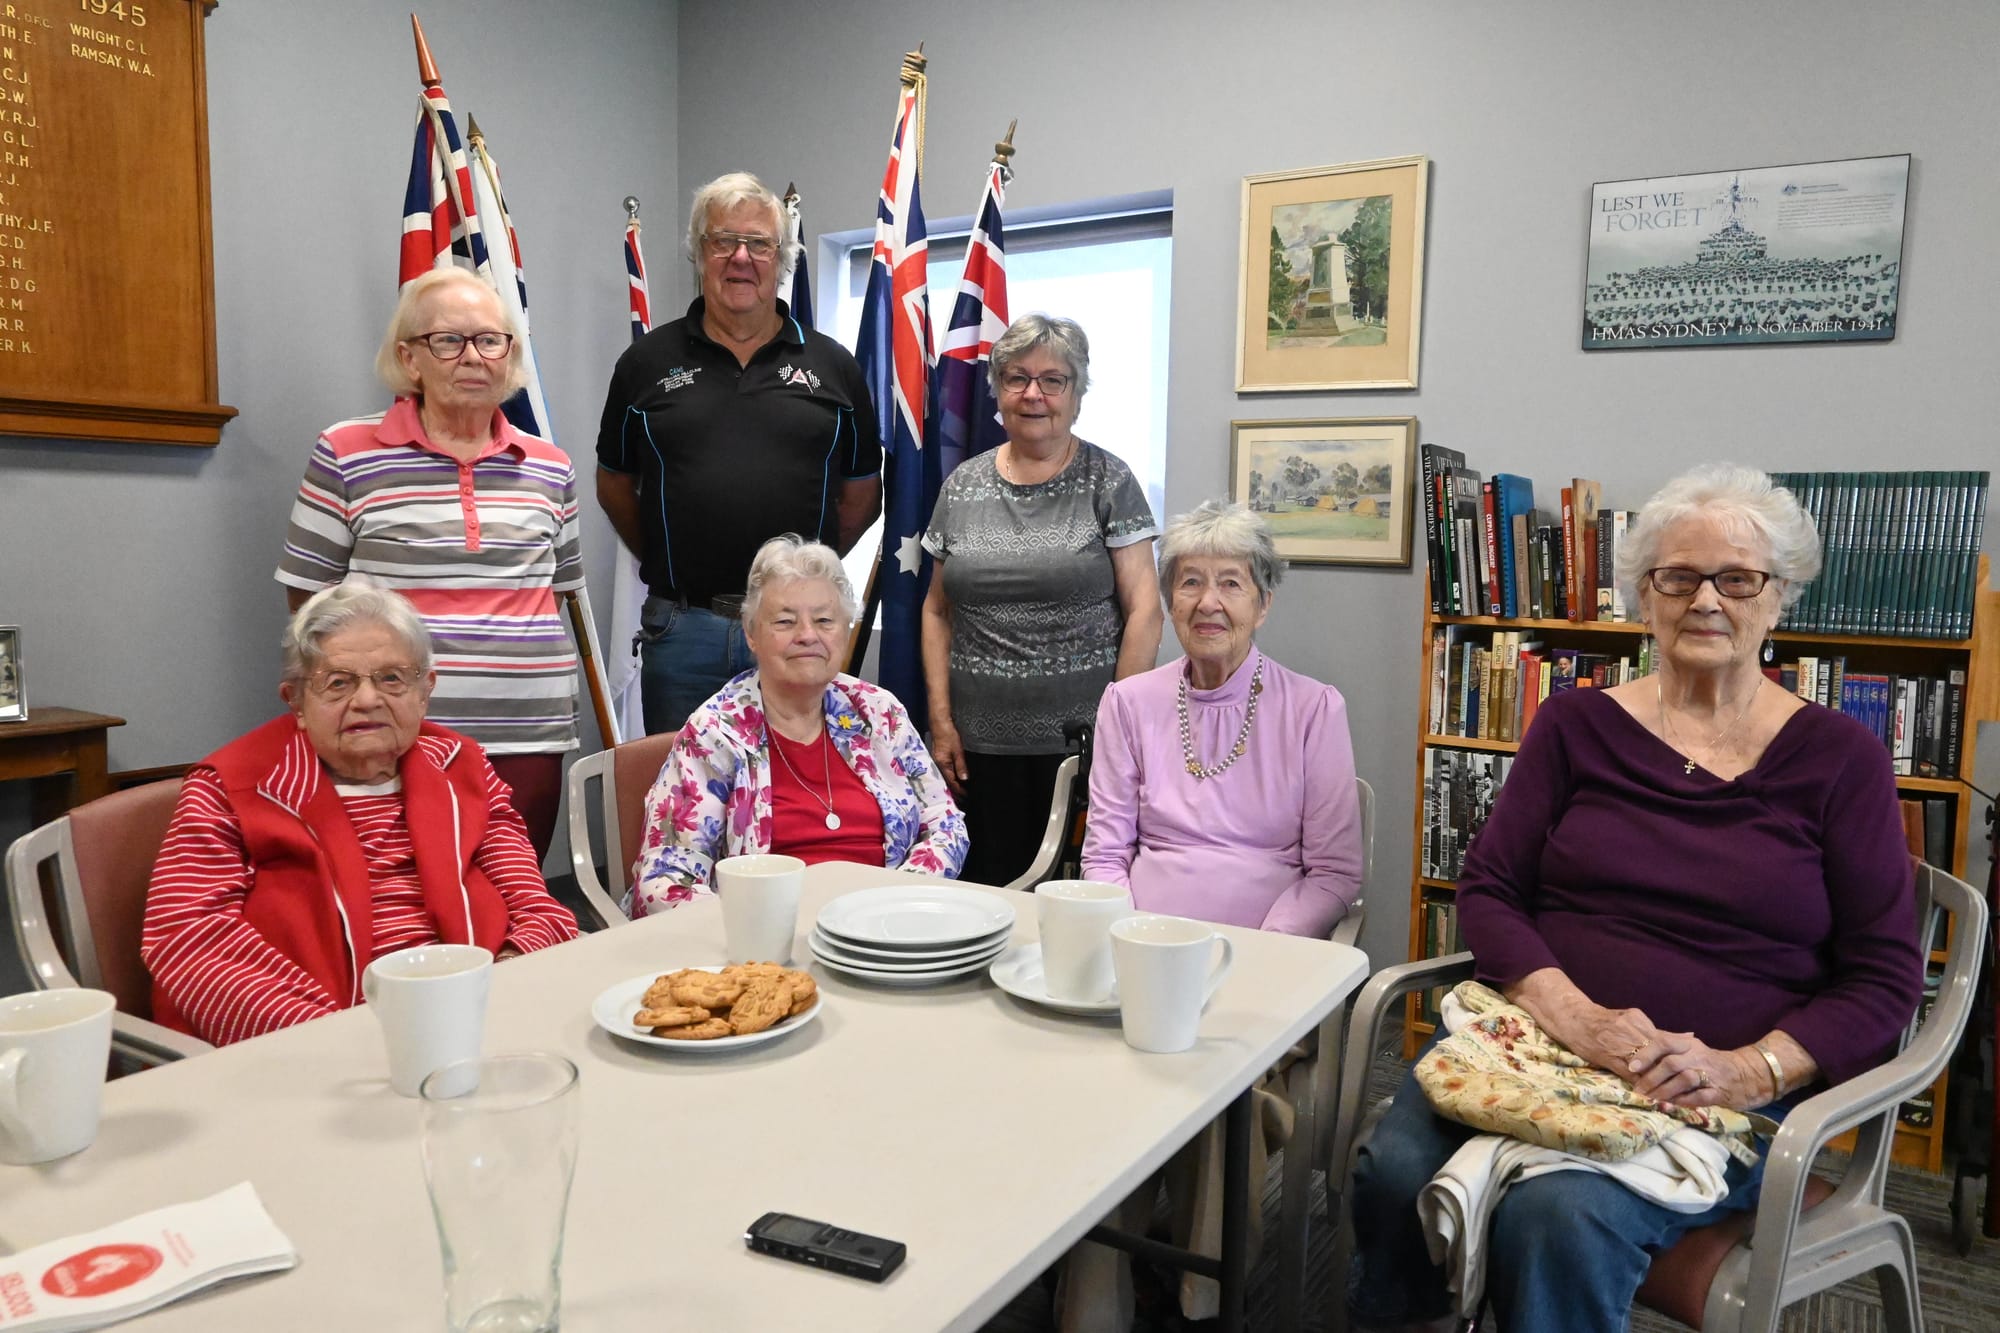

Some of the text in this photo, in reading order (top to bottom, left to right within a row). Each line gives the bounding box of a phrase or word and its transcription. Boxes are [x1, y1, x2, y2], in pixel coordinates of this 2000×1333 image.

[1602, 192, 1684, 212] LEST WE
[1606, 207, 1707, 232] FORGET
[1593, 319, 1883, 341] HMAS SYDNEY 19 NOVEMBER 1941
[1424, 456, 1433, 500] VIETNAM
[1426, 500, 1436, 541] EXPERIENCE
[1479, 700, 1487, 731] MEETING
[1948, 744, 1956, 764] YEARS
